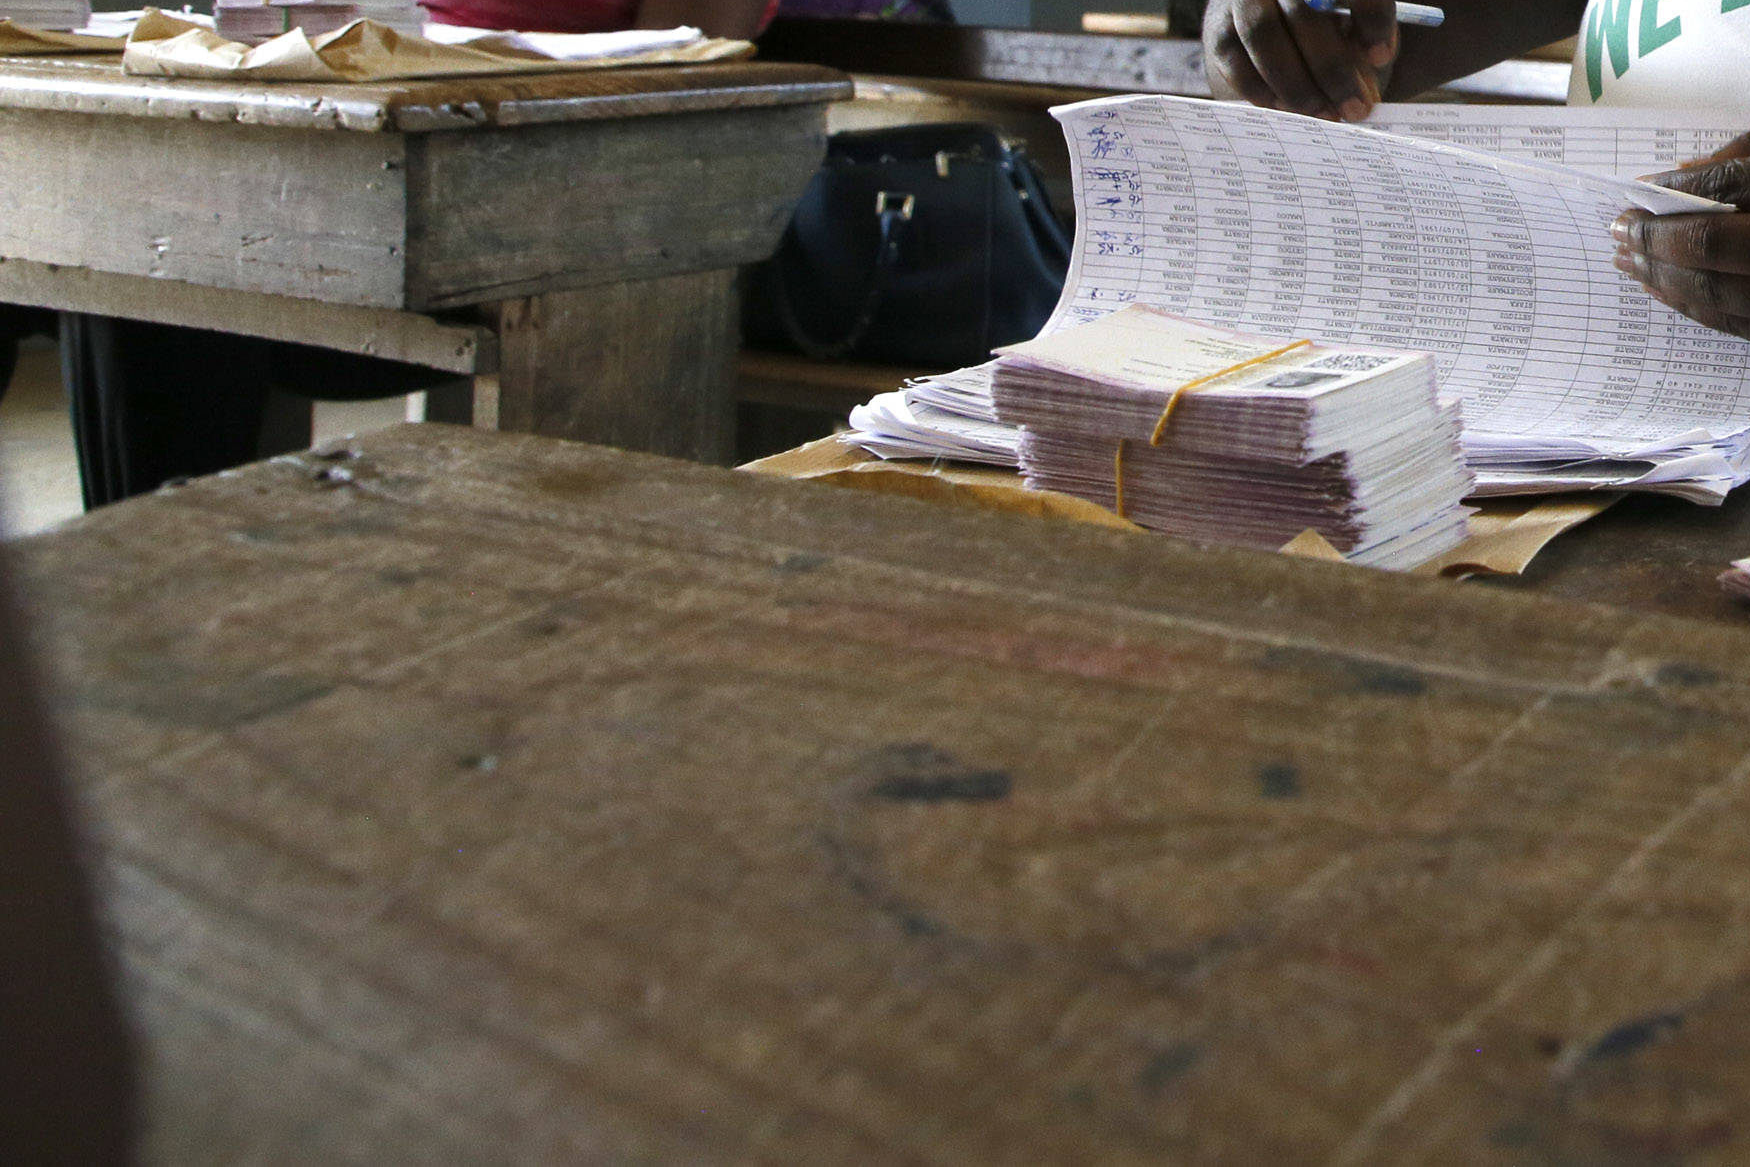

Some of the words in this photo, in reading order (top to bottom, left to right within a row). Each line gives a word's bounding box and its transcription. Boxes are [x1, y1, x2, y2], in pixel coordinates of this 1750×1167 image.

[1619, 298, 1648, 306] KONATE
[1619, 310, 1648, 318] KONATE
[1618, 322, 1647, 330] KONATE
[1617, 335, 1646, 343] KONATE
[1614, 346, 1643, 354] KONATE
[1611, 358, 1642, 366] KONATE
[1607, 375, 1636, 383] KONATE
